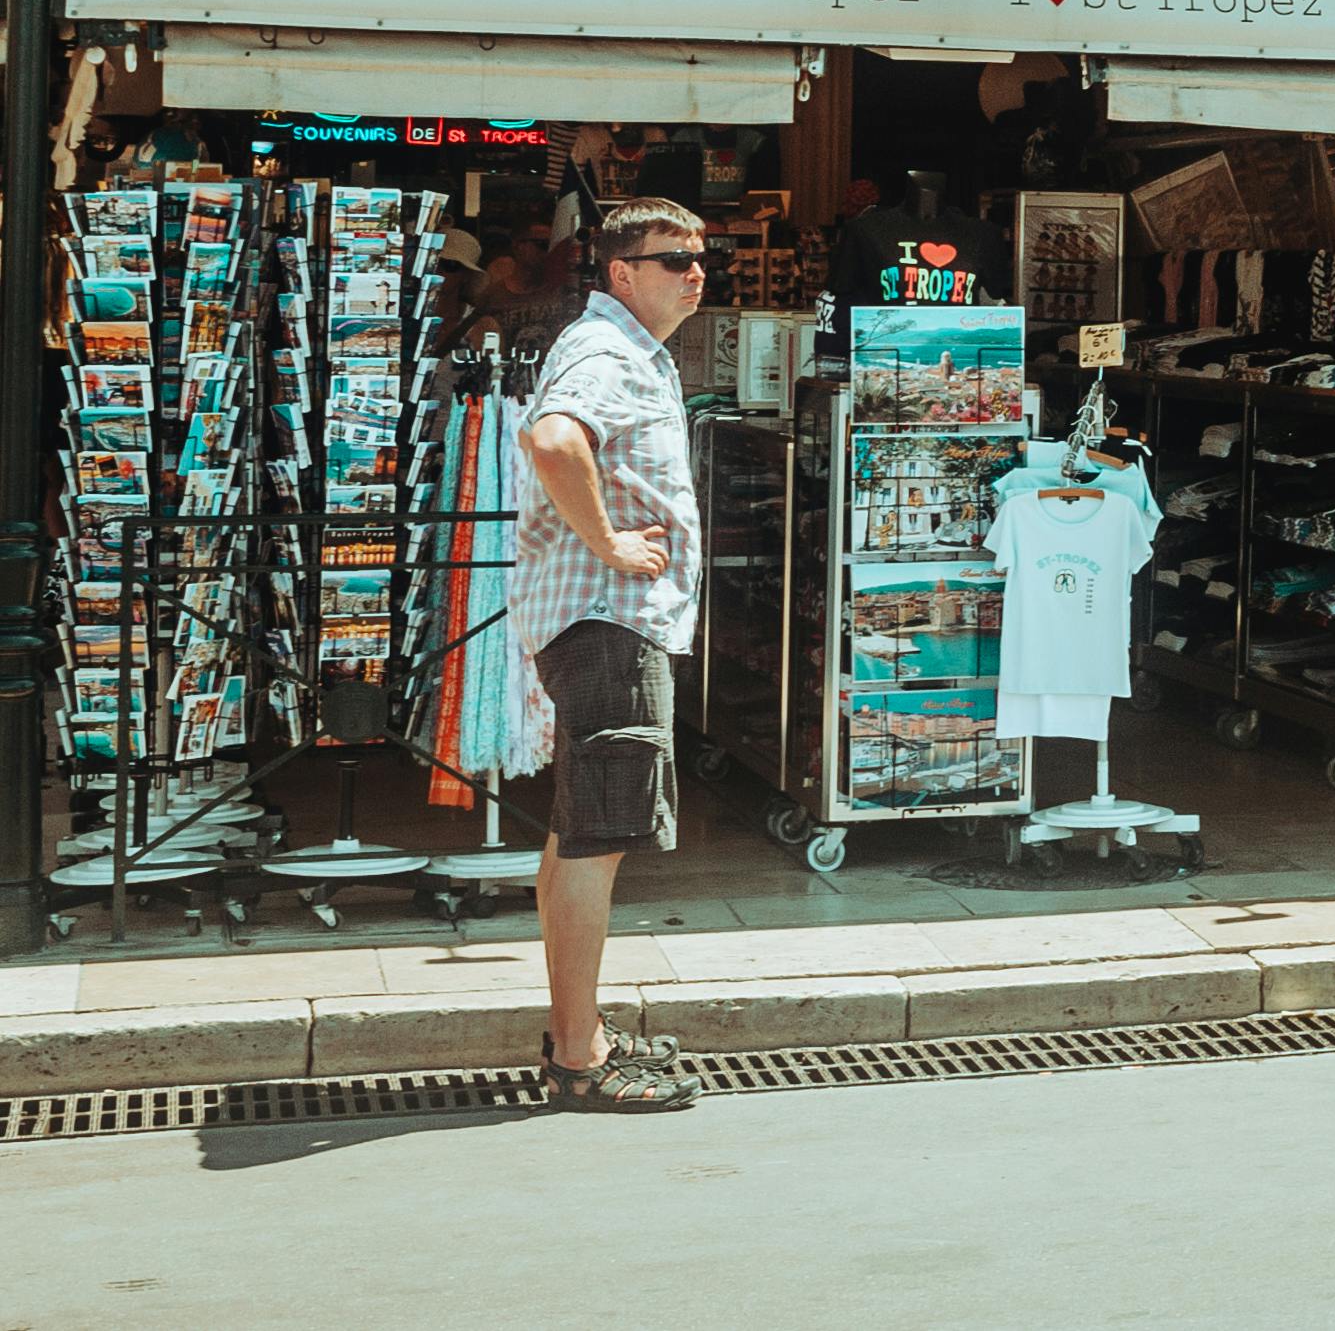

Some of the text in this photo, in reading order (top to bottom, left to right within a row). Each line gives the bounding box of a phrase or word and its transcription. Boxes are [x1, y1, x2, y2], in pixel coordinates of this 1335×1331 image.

[293, 126, 397, 142] SOUVENIRS
[412, 127, 435, 141] DE
[898, 241, 918, 265] I
[880, 266, 976, 305] ST TROPEZ
